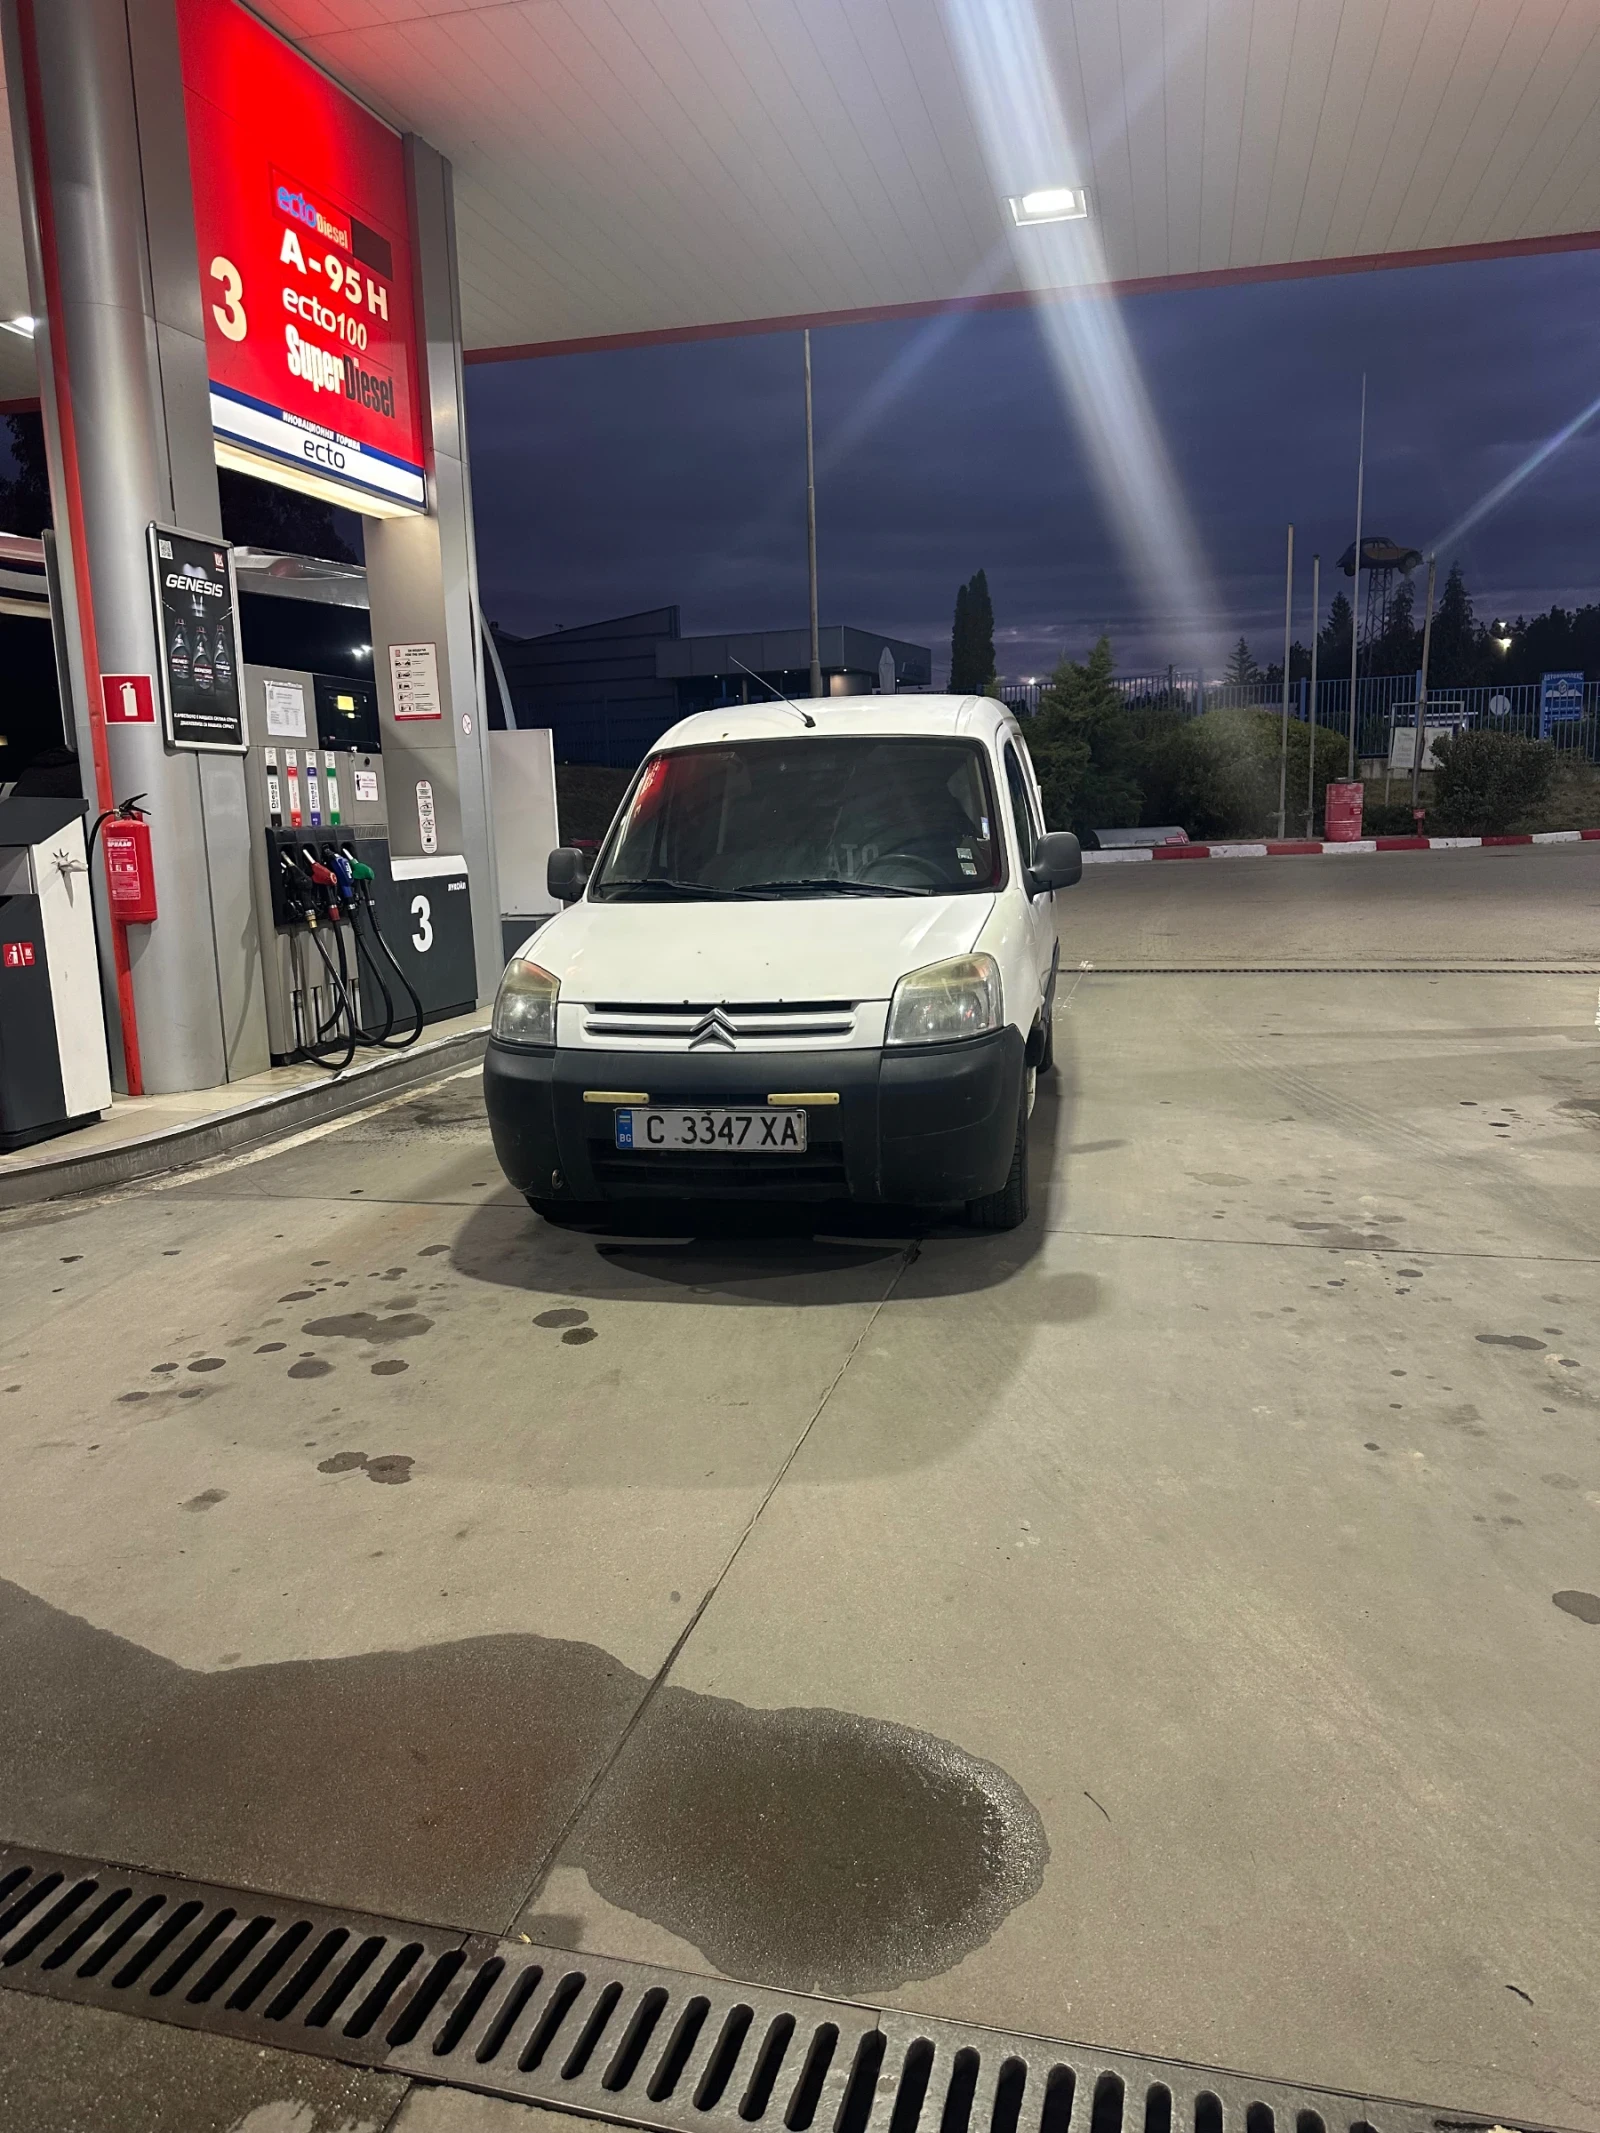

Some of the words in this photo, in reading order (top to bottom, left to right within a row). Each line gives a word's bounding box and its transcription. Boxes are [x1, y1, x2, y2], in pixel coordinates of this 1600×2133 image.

[210, 256, 248, 342] 3
[303, 439, 346, 469] ecto
[166, 573, 224, 598] GENESIS
[410, 894, 434, 953] 3
[619, 1133, 632, 1143] BG
[680, 1116, 752, 1145] 3347
